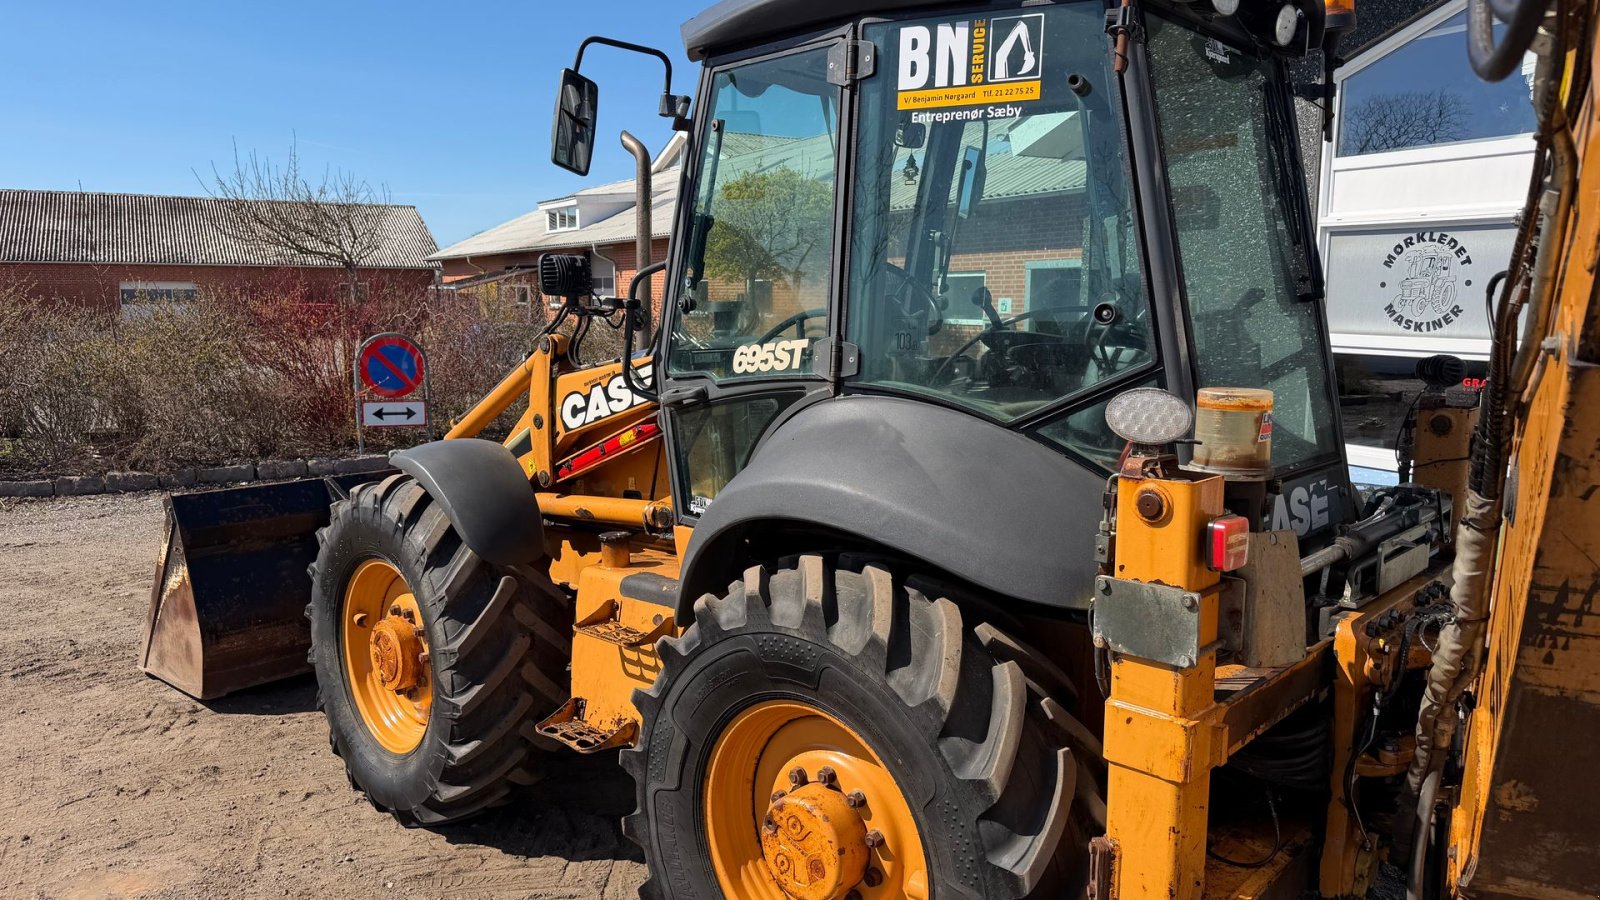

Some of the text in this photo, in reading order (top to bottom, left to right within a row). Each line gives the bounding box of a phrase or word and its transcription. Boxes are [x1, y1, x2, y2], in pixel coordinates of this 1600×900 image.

[897, 21, 970, 91] BN
[971, 18, 987, 84] SERVICE
[912, 95, 943, 104] Benjamin
[944, 92, 976, 102] Nørgaard
[983, 90, 994, 98] Tlf.
[994, 89, 1004, 97] 21
[1004, 88, 1014, 96] 22
[1015, 87, 1024, 95] 75
[1025, 86, 1034, 94] 25
[912, 104, 1022, 124] Entreprenør Sæby
[1382, 231, 1473, 269] MØRKLEDET
[1383, 303, 1464, 333] MASKINER
[732, 338, 809, 374] 695ST
